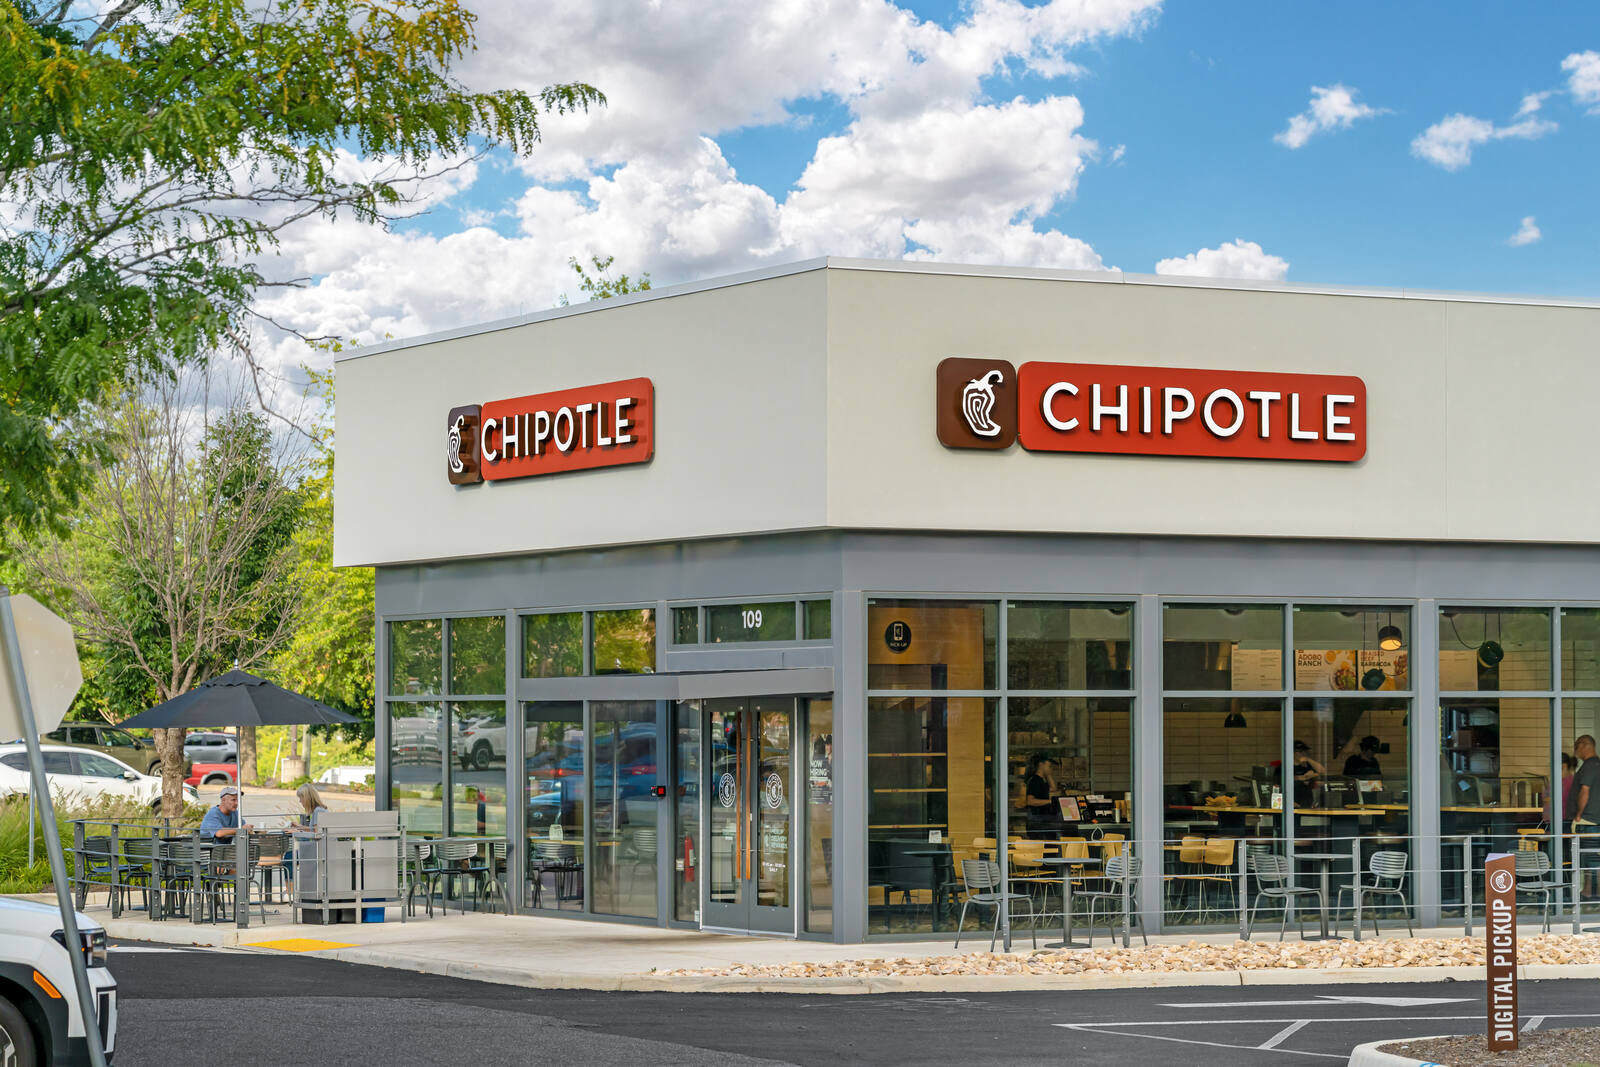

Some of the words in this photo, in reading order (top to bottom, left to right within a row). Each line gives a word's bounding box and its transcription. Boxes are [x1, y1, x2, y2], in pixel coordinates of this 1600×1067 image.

[481, 397, 635, 462] CHIPOTLE
[1042, 381, 1356, 441] CHIPOTLE
[741, 609, 763, 629] 109
[810, 760, 823, 768] NOW
[810, 768, 828, 776] HIRING
[1492, 898, 1513, 967] PICKUP
[1494, 972, 1514, 1042] DIGITAL
